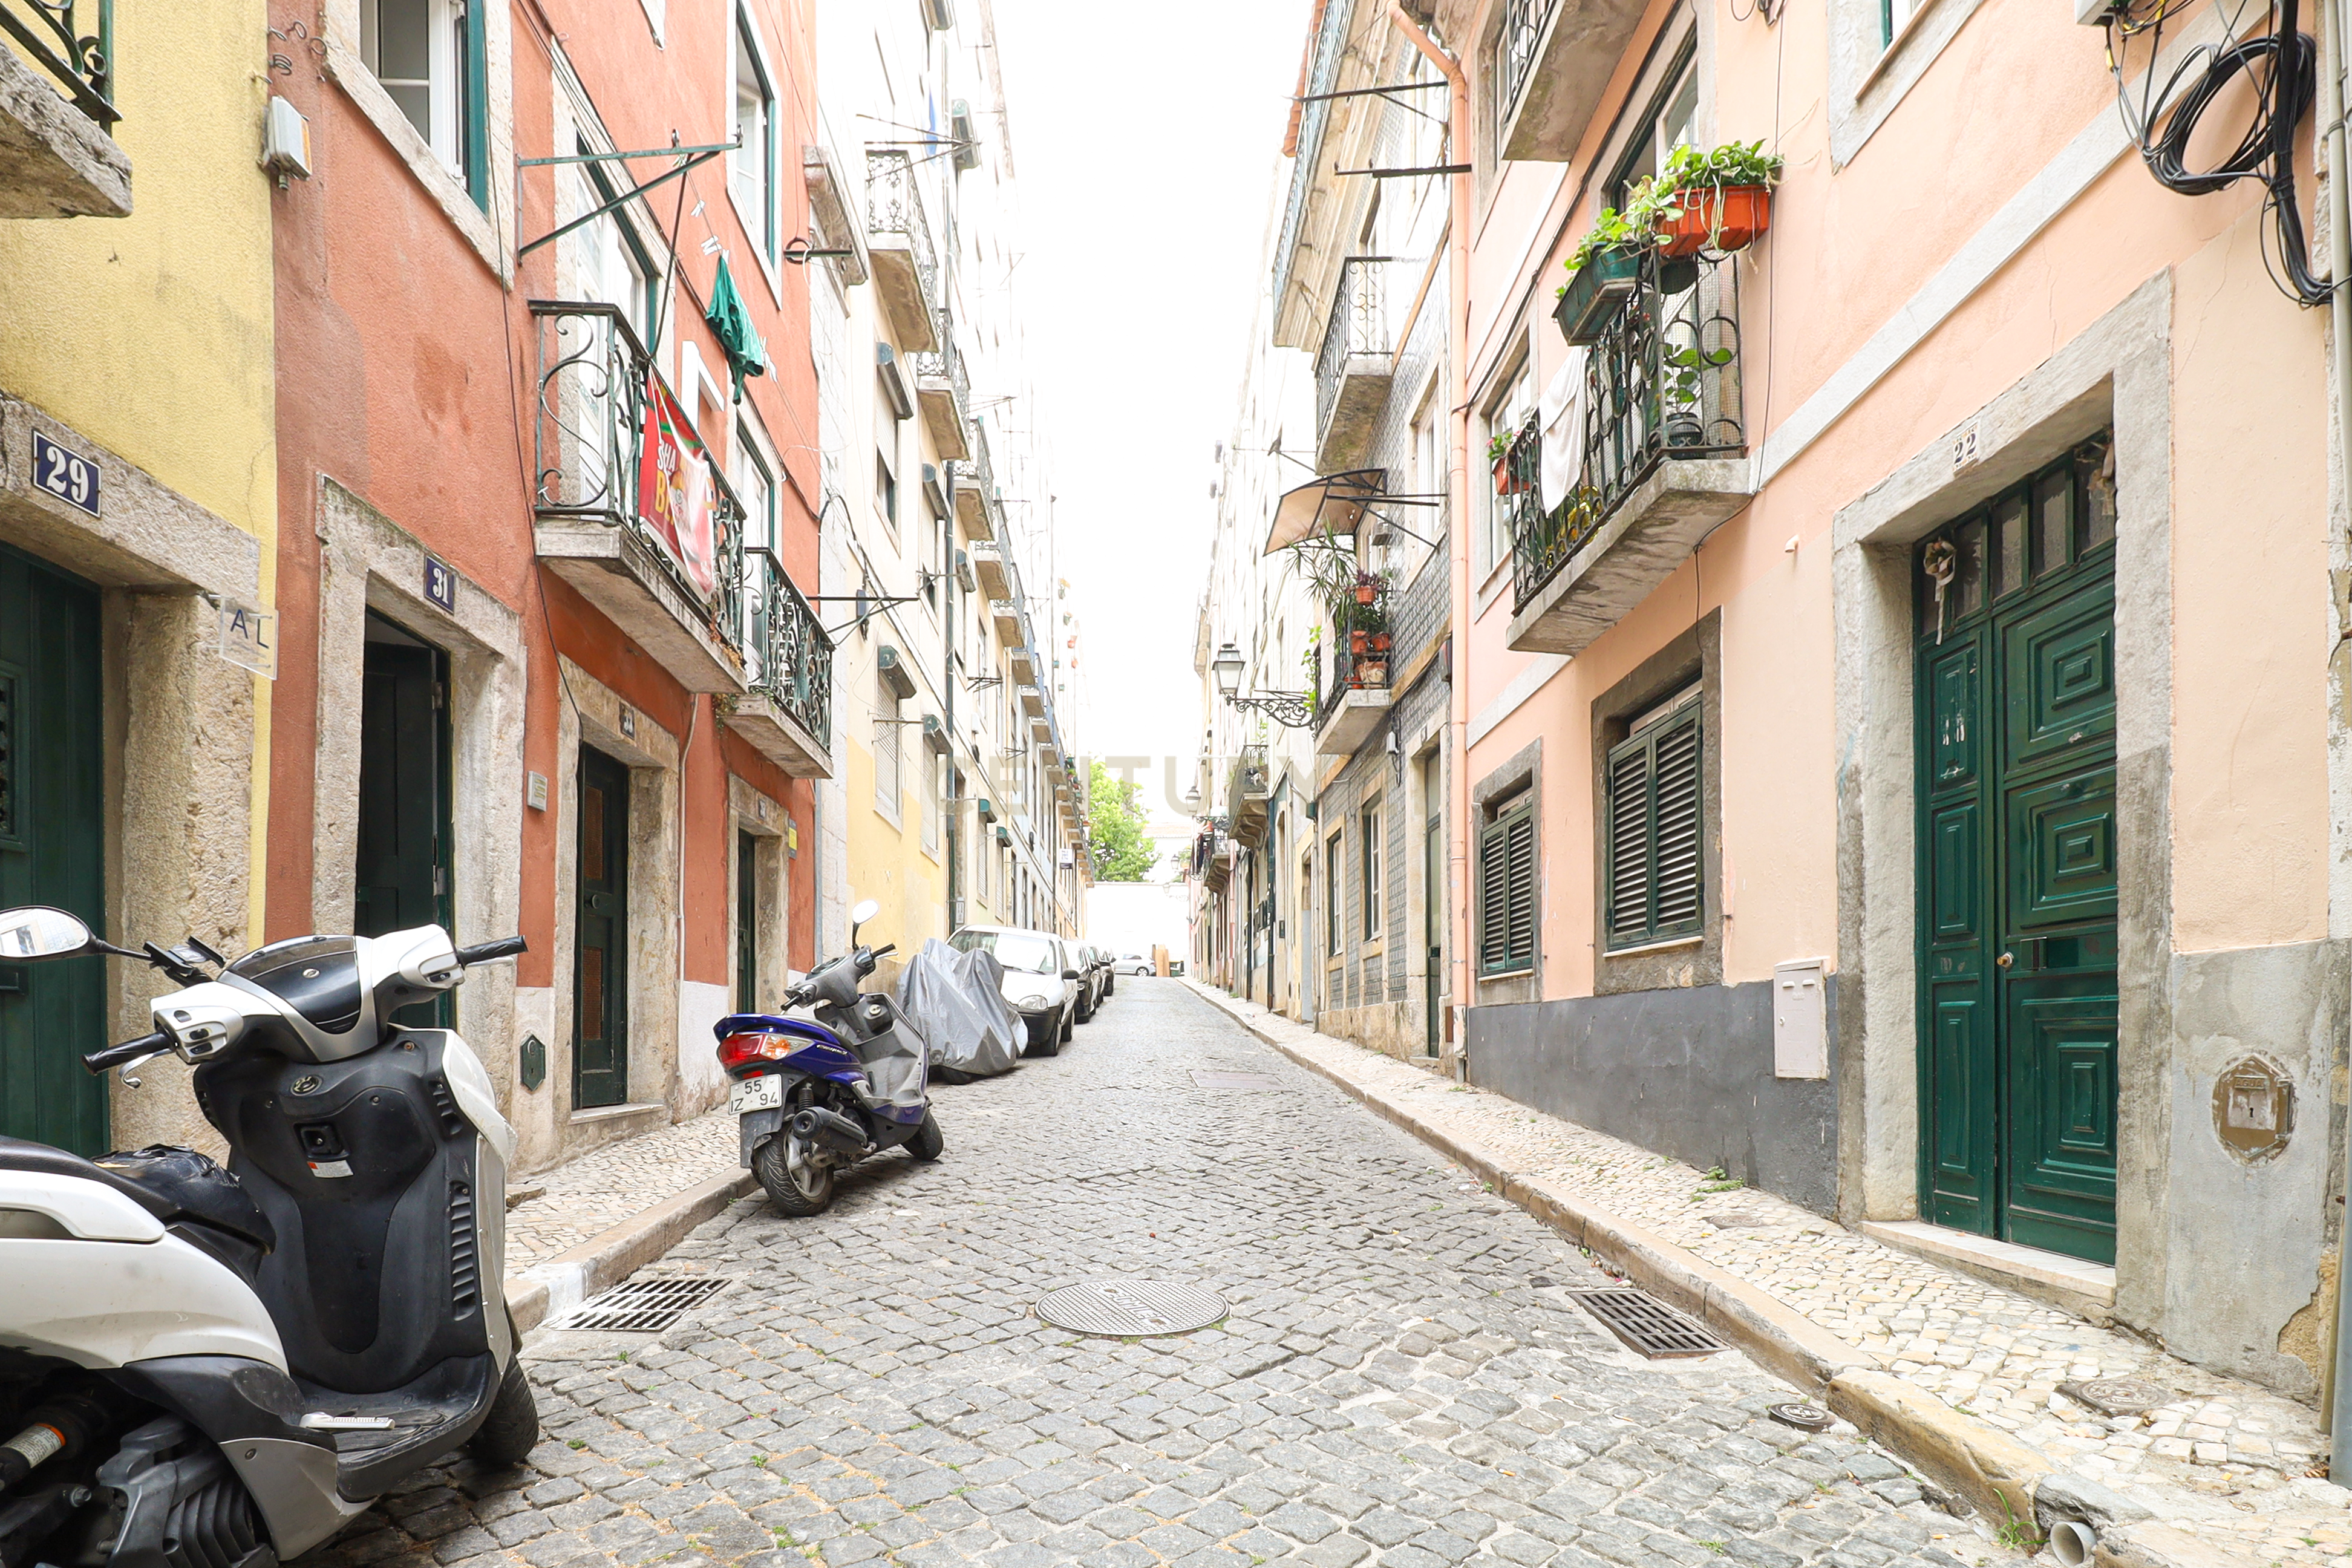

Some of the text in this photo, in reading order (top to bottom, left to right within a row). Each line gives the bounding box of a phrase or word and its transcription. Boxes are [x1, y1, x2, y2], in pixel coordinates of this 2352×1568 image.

[1954, 433, 1976, 464] 22
[47, 446, 90, 503] 29
[432, 567, 449, 604] 31
[730, 1091, 778, 1112] IZ 94
[745, 1079, 762, 1094] 55
